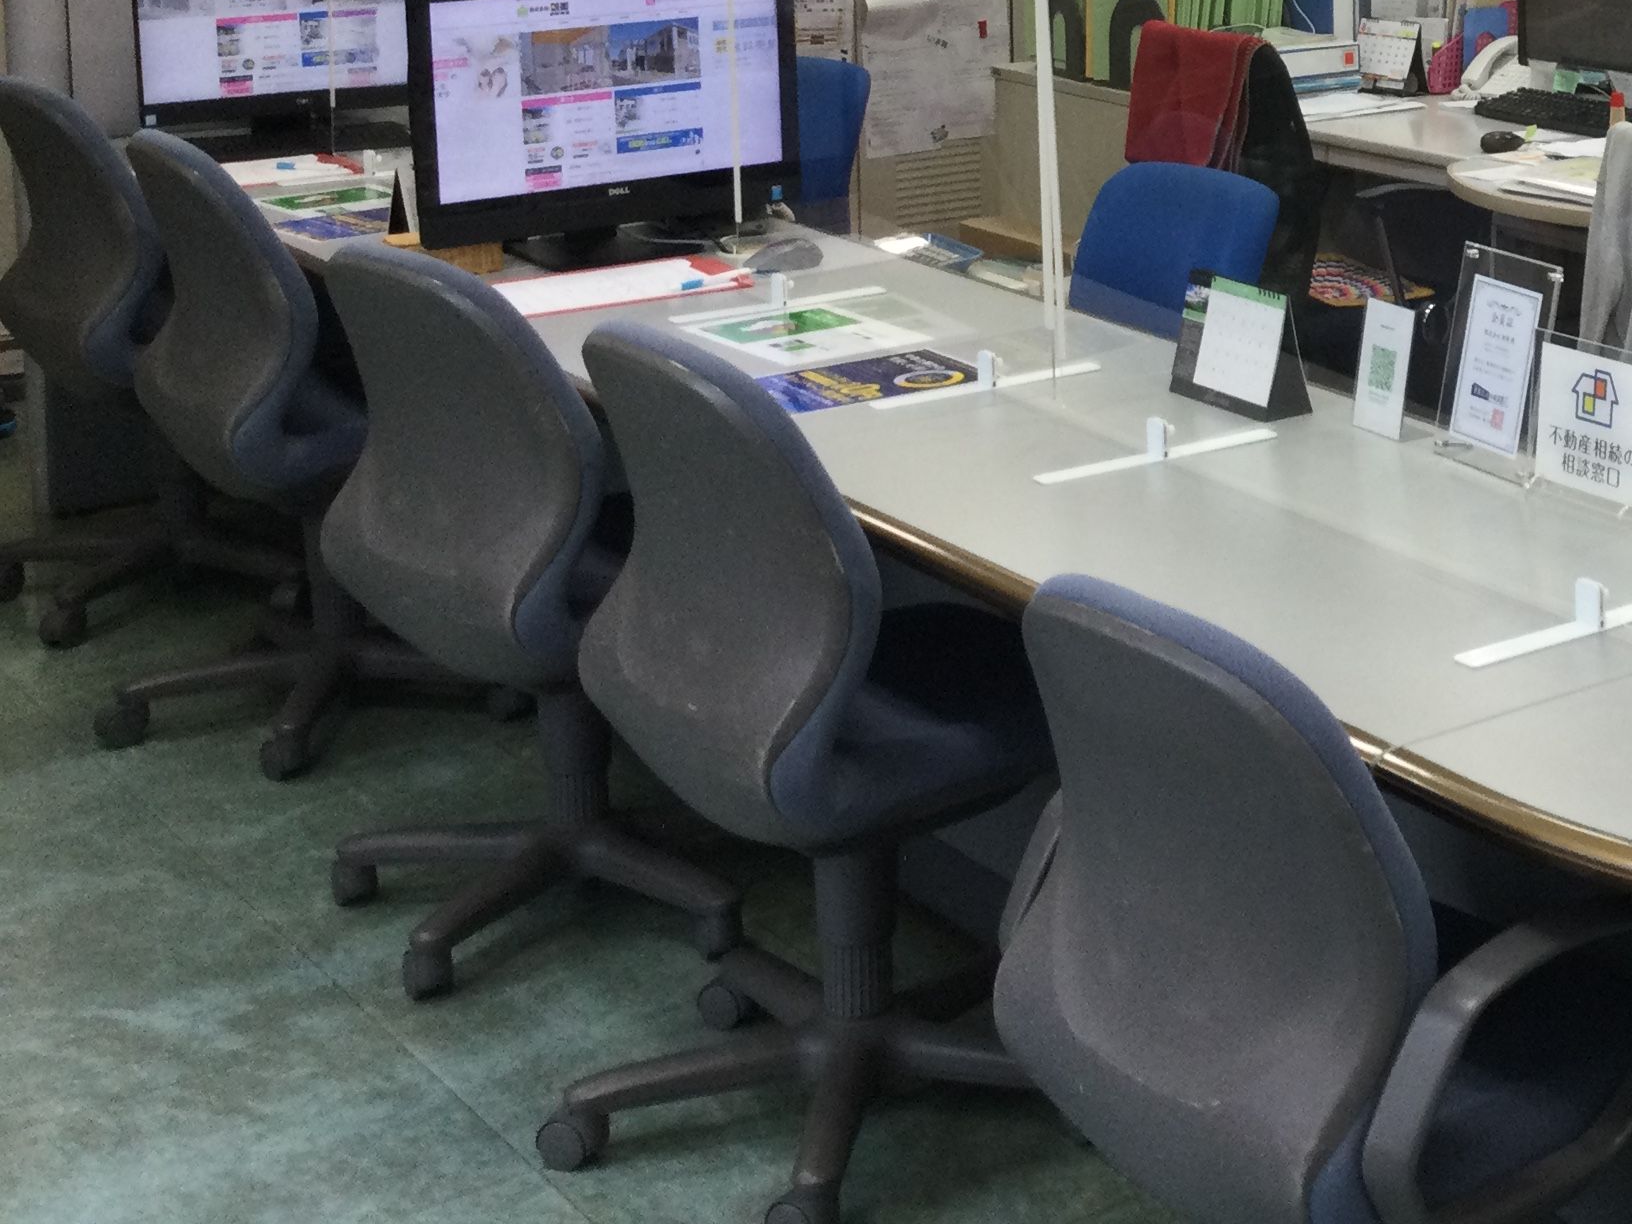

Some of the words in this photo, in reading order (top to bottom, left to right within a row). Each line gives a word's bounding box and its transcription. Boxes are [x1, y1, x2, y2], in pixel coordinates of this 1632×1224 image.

[607, 185, 630, 196] DELL
[1561, 454, 1621, 489] 相談窓口
